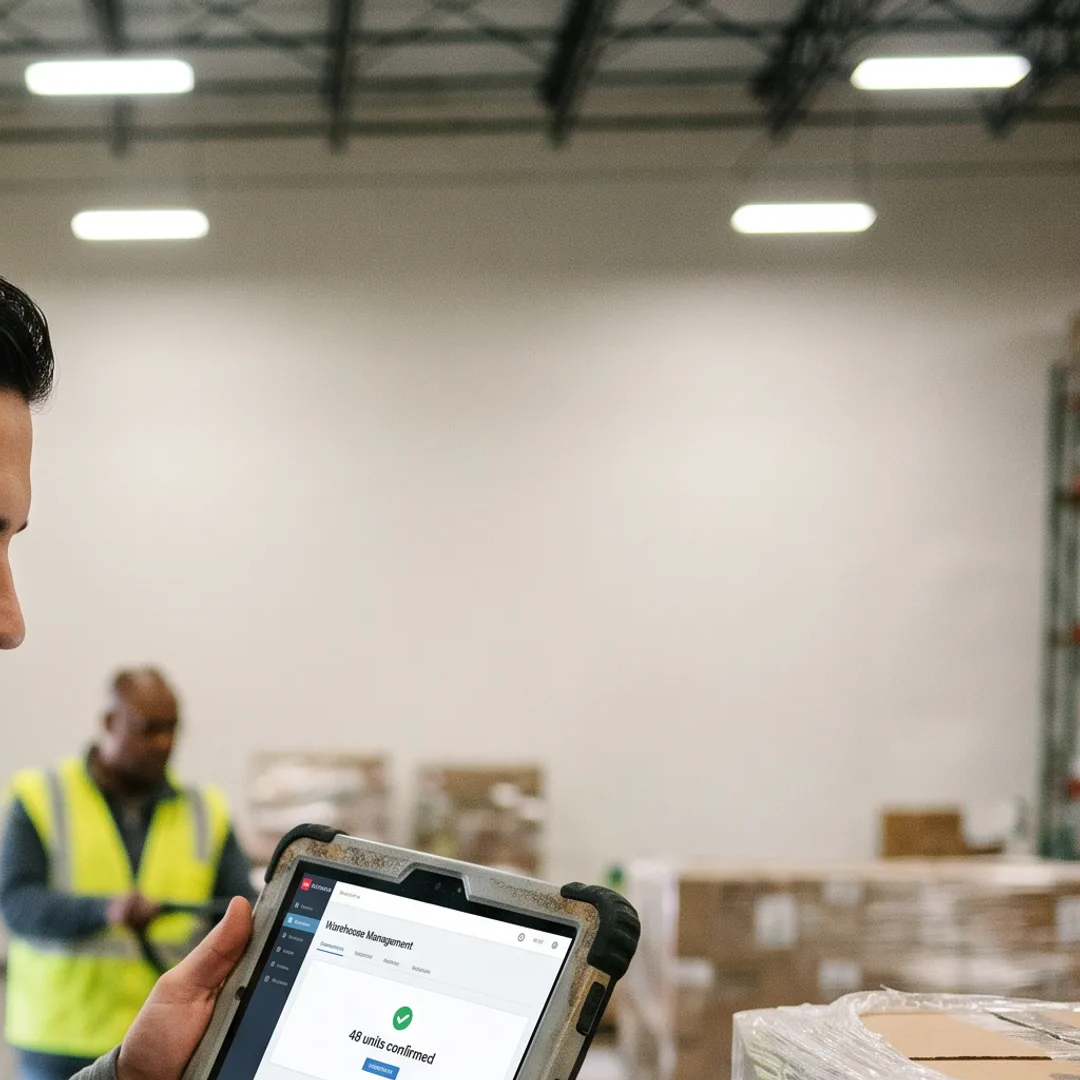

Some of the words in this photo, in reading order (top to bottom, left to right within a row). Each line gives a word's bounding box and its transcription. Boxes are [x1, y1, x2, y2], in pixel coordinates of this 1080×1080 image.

[366, 930, 414, 950] Management
[349, 1030, 362, 1042] 48
[386, 1044, 436, 1065] confirmed
